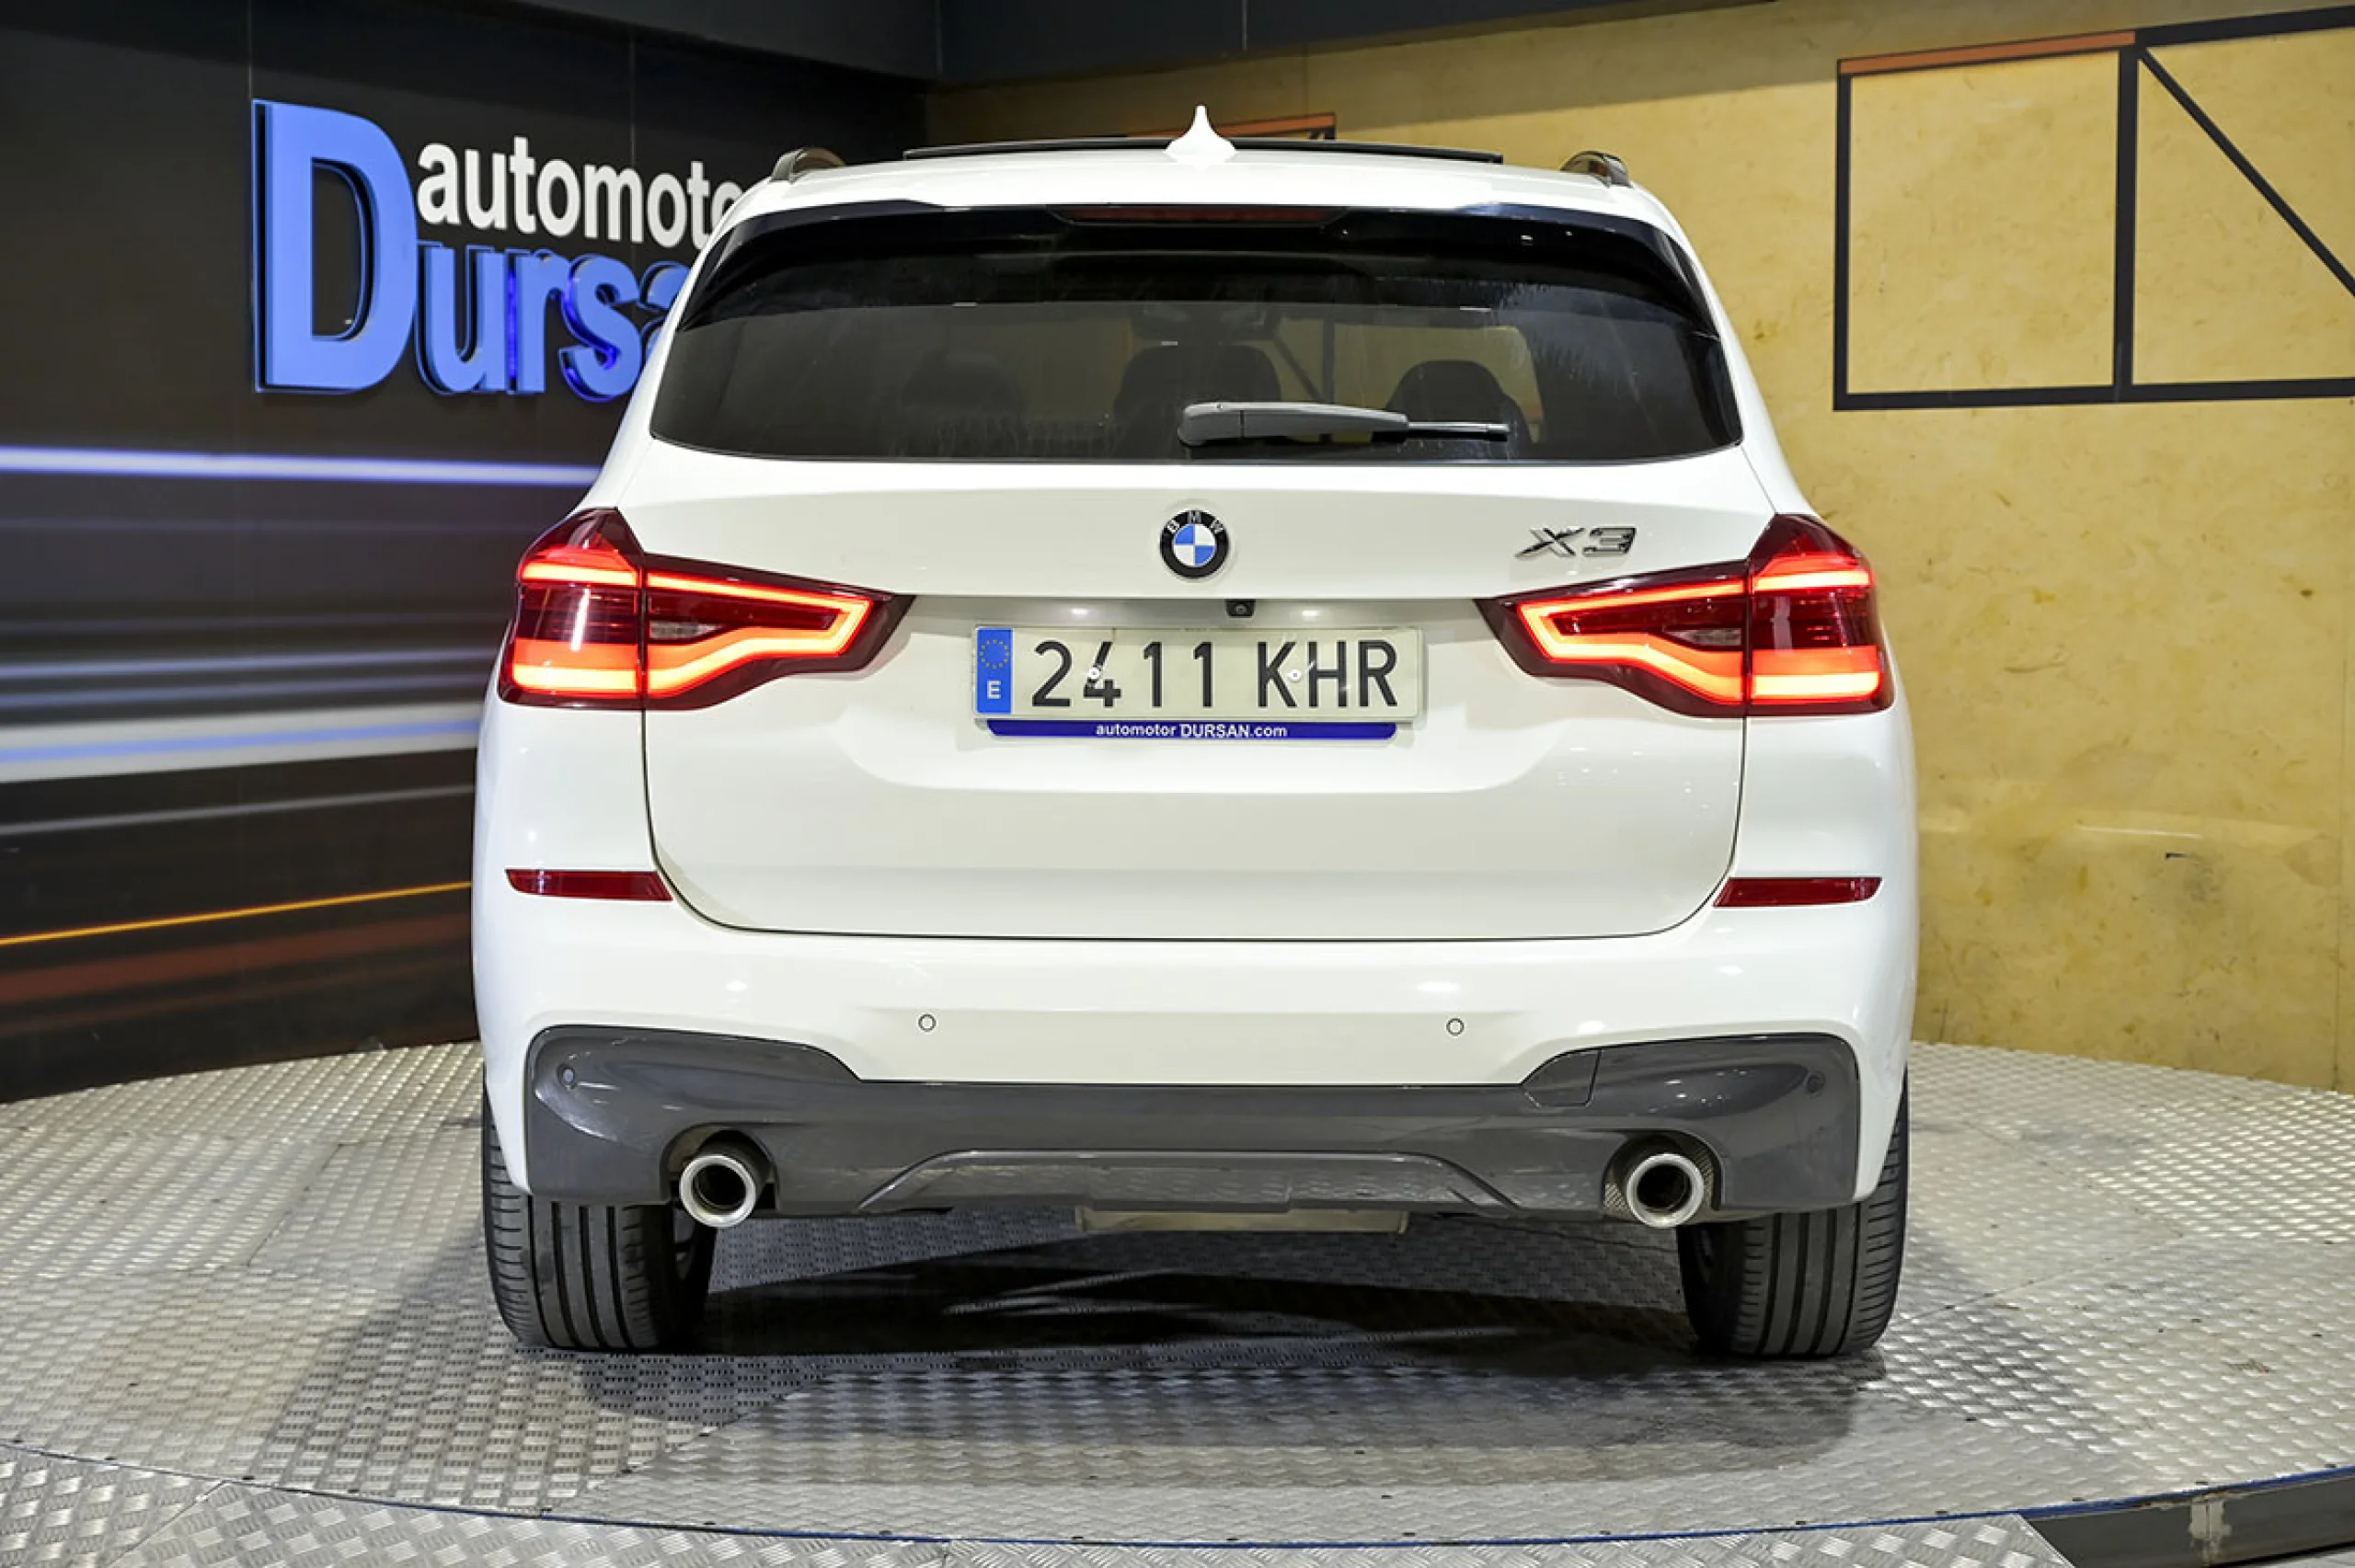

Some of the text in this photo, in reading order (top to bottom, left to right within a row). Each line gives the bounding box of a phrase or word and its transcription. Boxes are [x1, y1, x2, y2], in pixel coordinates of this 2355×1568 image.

[1514, 525, 1637, 558] X3
[1031, 640, 1399, 707] 2411 KHR
[987, 680, 1002, 700] E
[1096, 724, 1288, 738] automotor DURSAN.com
